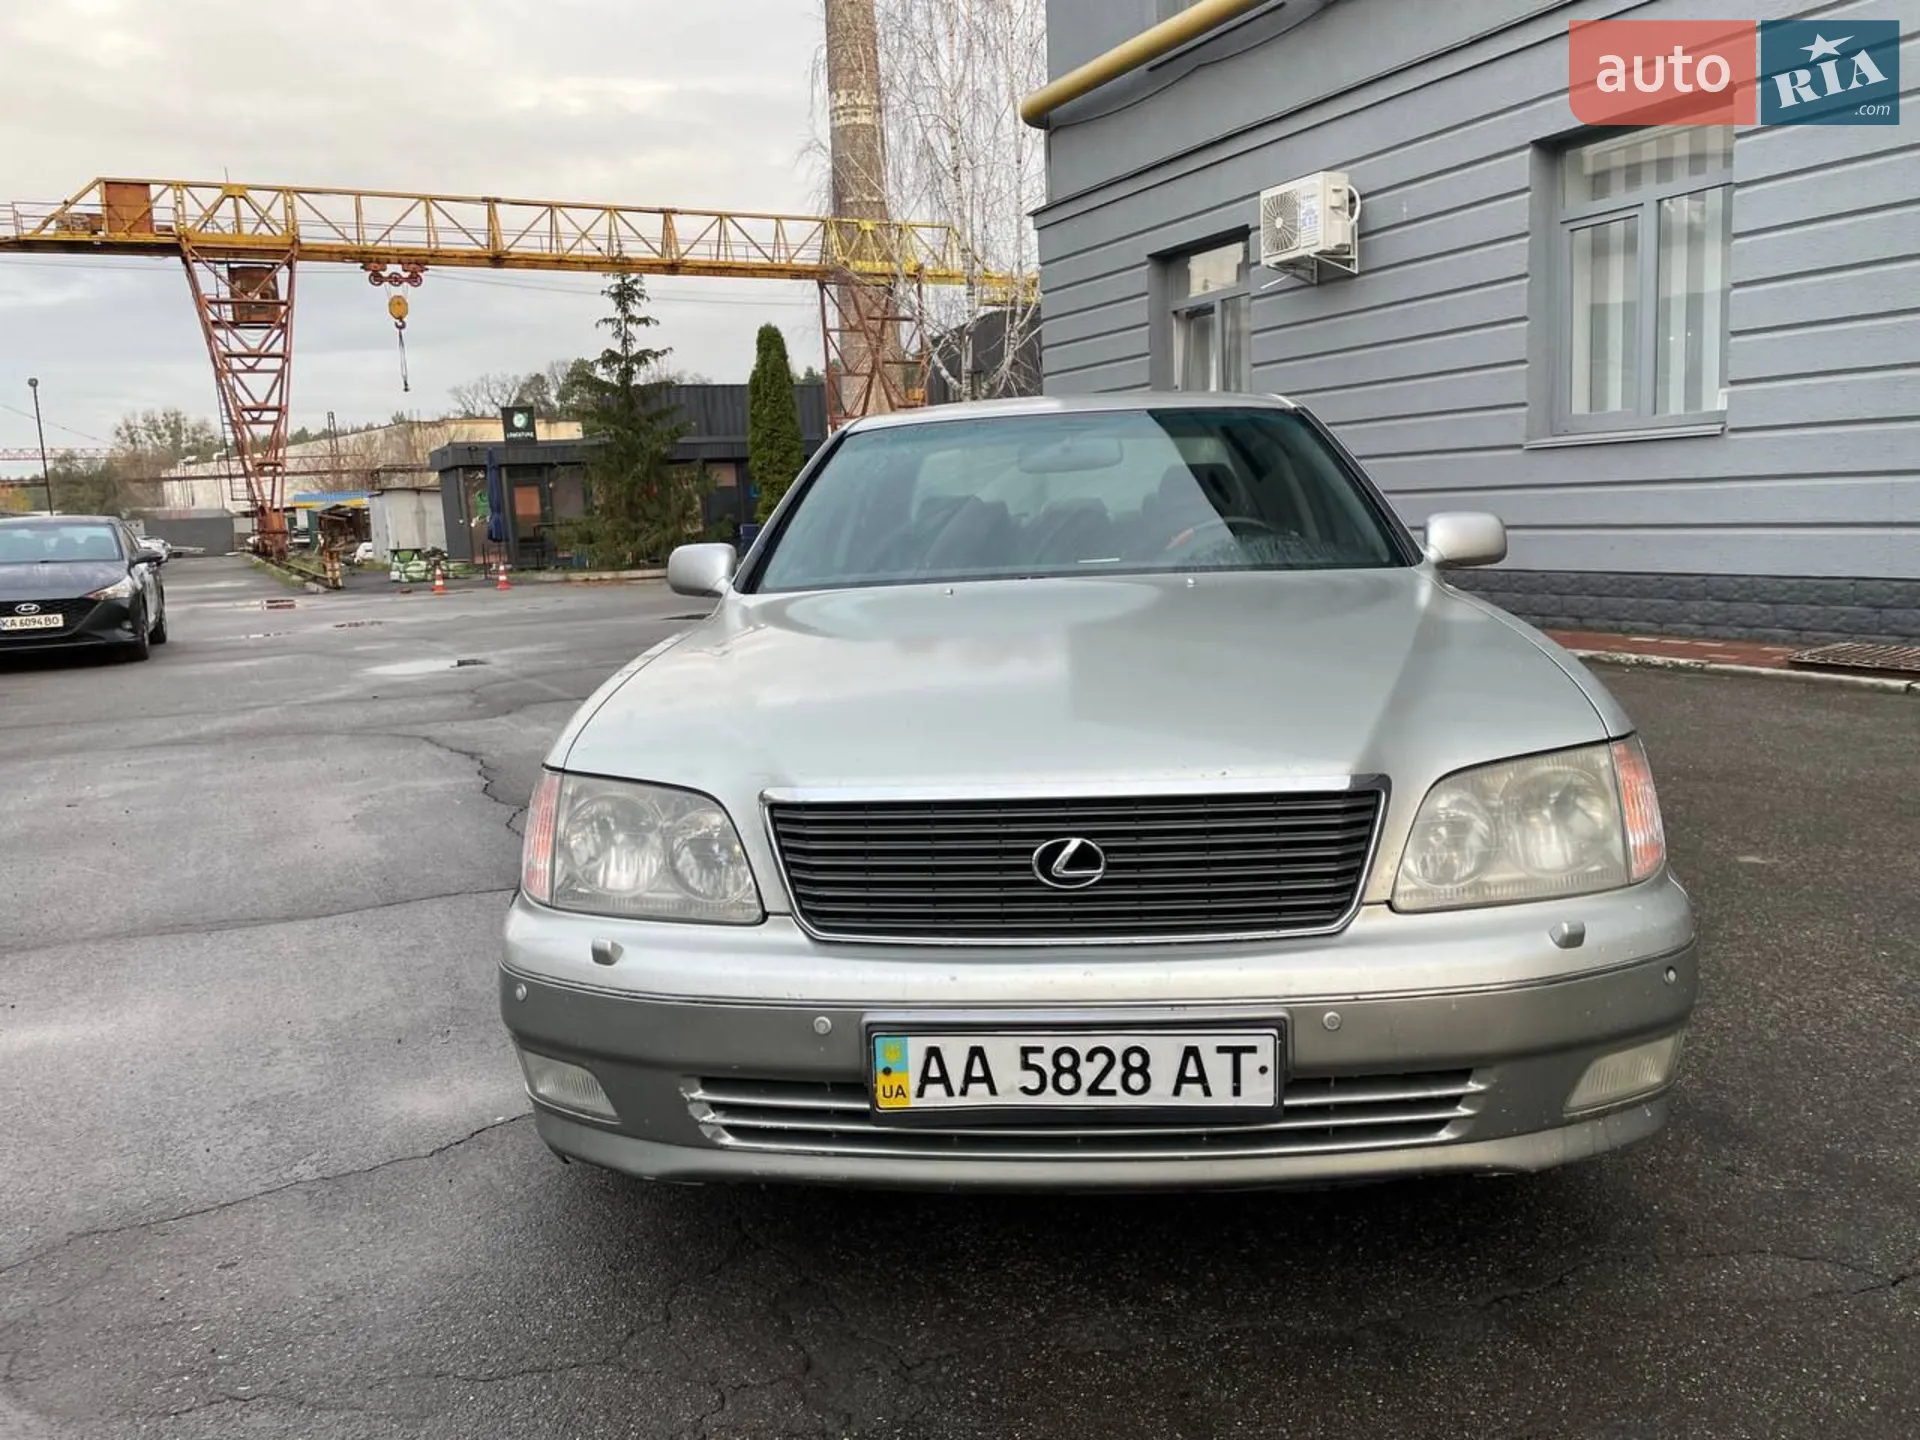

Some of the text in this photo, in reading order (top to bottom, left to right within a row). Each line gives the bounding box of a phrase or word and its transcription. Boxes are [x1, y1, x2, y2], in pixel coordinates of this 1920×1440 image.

[915, 1045, 1257, 1099] AA 5828 AT
[882, 1084, 907, 1100] UA
